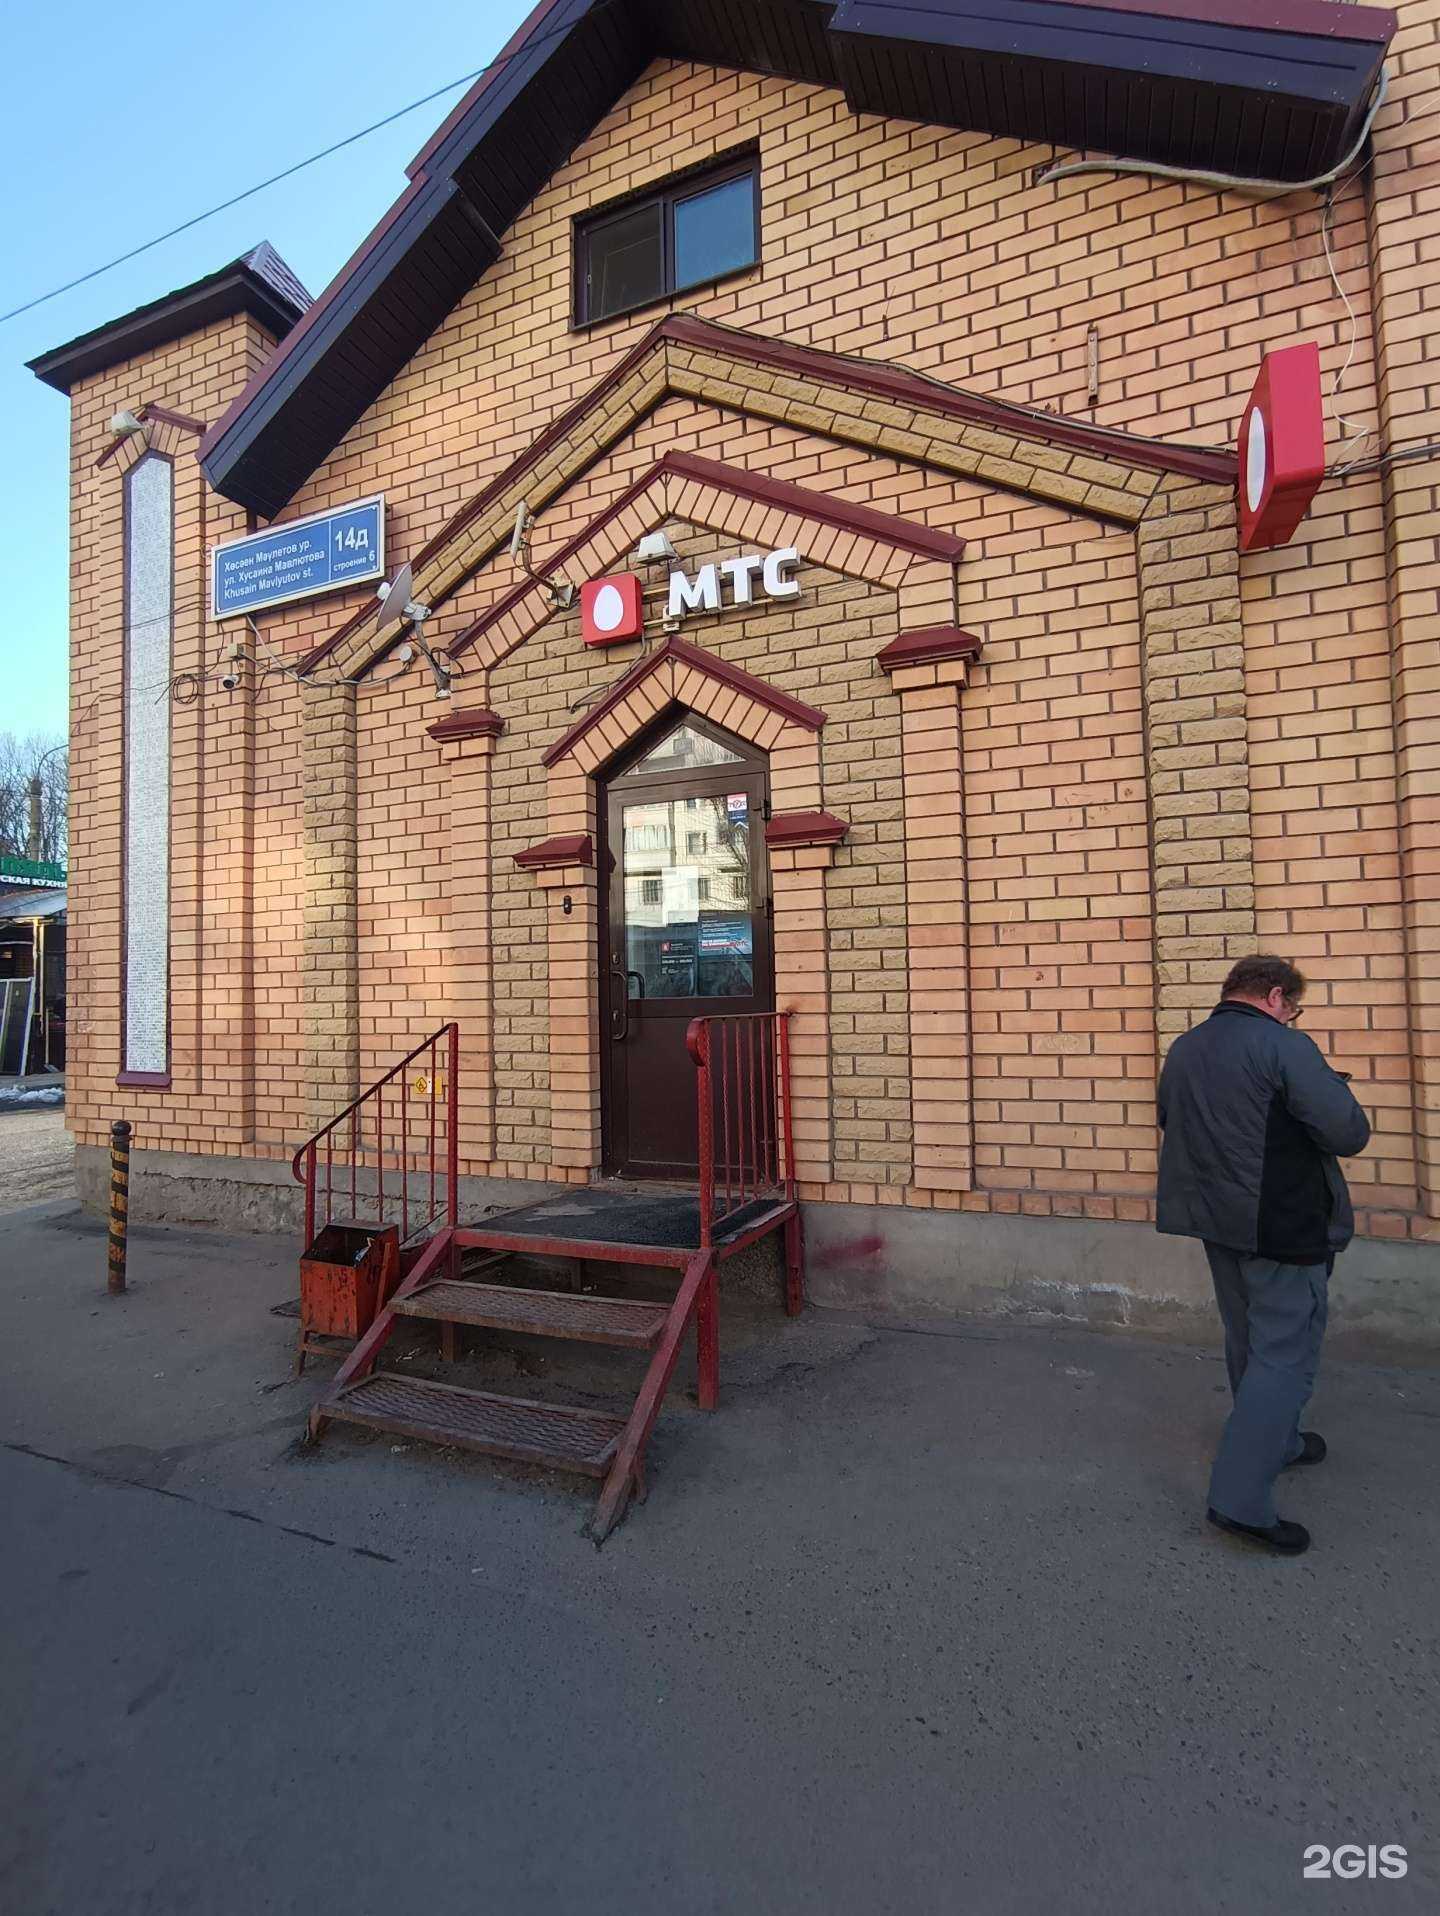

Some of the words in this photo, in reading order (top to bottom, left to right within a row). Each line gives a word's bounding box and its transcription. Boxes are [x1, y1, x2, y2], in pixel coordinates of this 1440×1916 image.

[299, 539, 313, 554] ур.
[333, 557, 366, 572] строение
[368, 550, 376, 561] 6
[224, 574, 236, 588] ул.
[238, 565, 273, 583] Хусаина
[275, 550, 325, 572] Мавлютова
[224, 583, 257, 600] Khusain
[259, 571, 301, 590] Mavlyutov
[302, 567, 314, 578] st.
[668, 547, 802, 620] МТС
